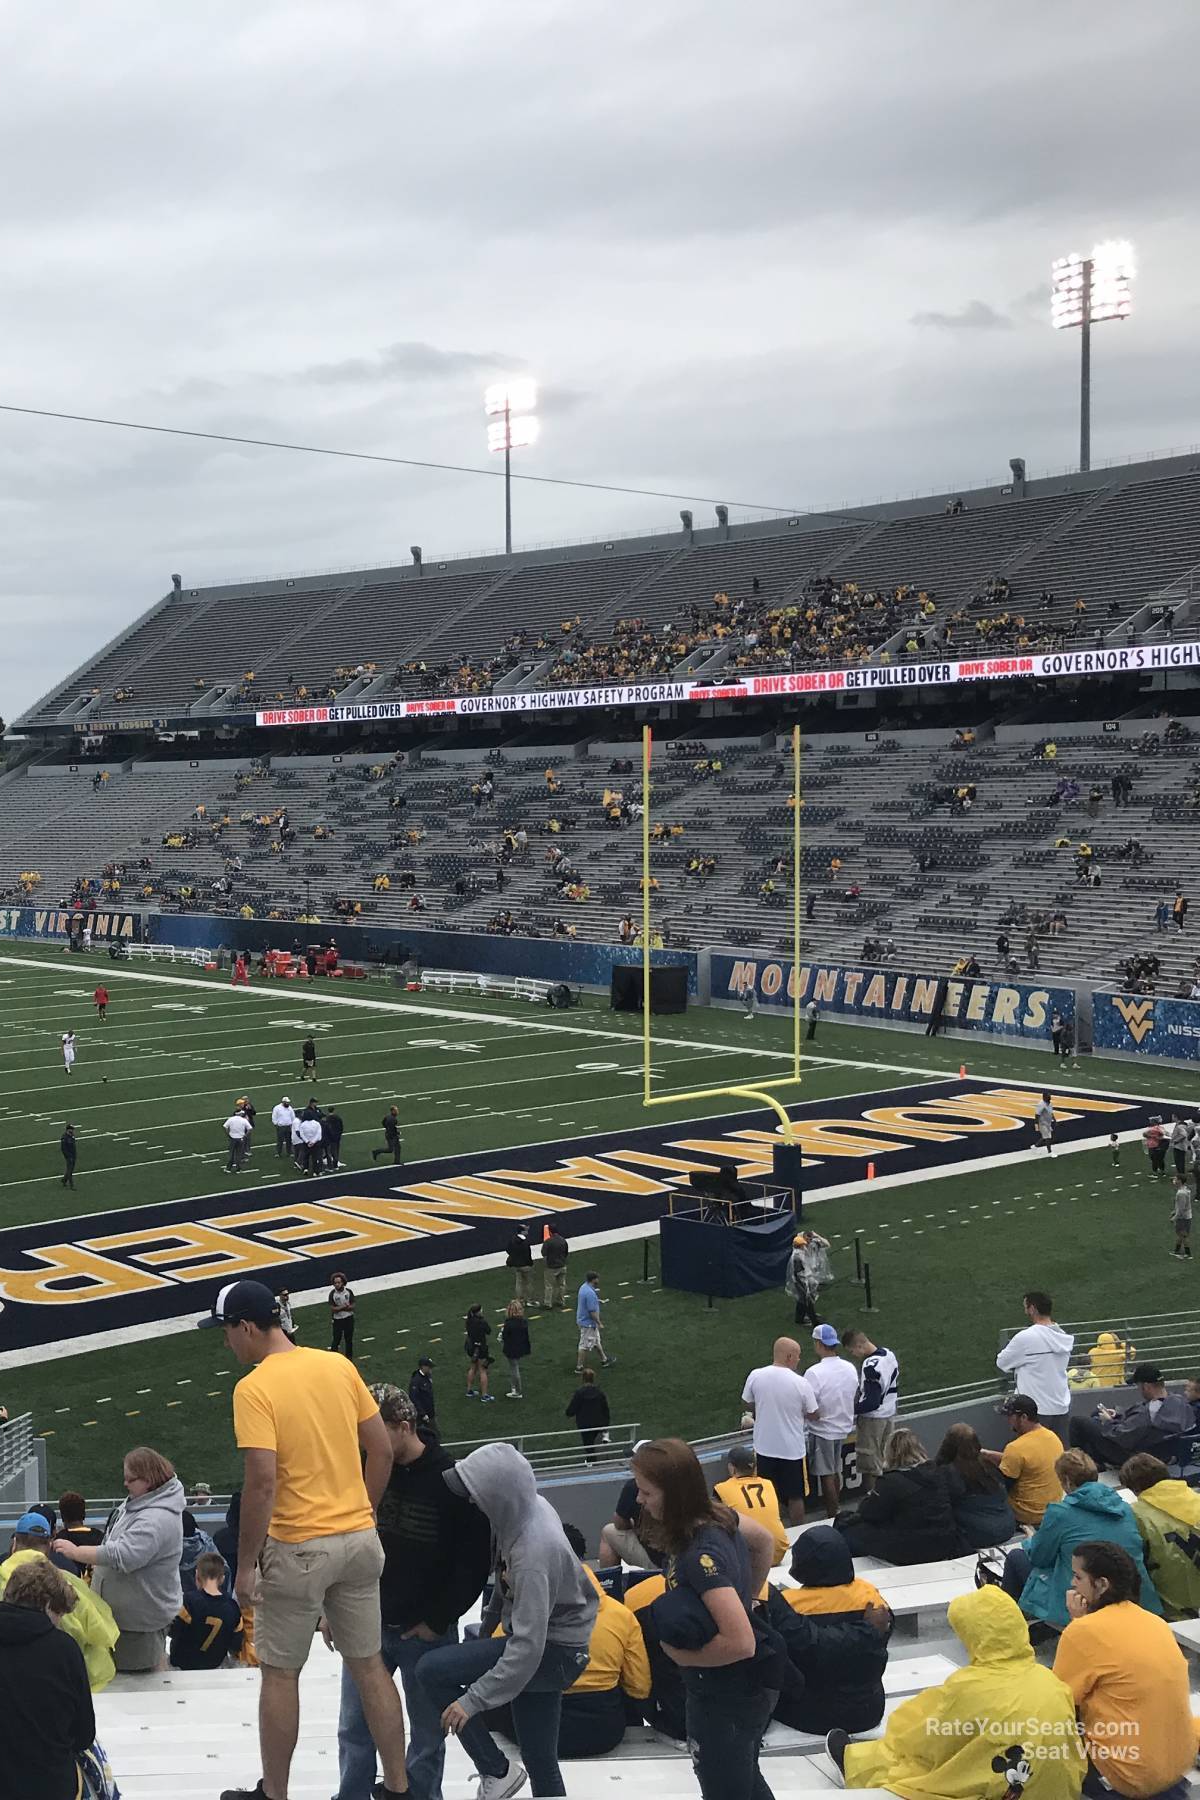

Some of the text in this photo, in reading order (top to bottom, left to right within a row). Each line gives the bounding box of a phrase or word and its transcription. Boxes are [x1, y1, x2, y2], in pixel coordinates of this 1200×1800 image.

[959, 659, 1033, 676] DRIVE SOBER OR
[1042, 649, 1145, 674] GOVERNOR'S
[754, 676, 787, 694] DRIVE
[789, 674, 826, 692] SOBER
[828, 672, 844, 688] OR
[846, 670, 868, 688] GET
[870, 668, 916, 685] PULLED
[918, 665, 951, 683] OVER
[406, 700, 455, 713] DRIVE SOBER OR
[460, 684, 684, 713] GOVERNOR'S HIGHWAY SAFETY PROGRAM
[263, 711, 287, 725] DRIVE
[288, 709, 315, 723] SOBER
[316, 708, 328, 721] OR
[329, 706, 345, 720] GET
[346, 704, 378, 719] PULLED
[379, 703, 401, 718] OVER
[727, 960, 1050, 1029] MOUNTAINEERS
[741, 1484, 766, 1508] 17
[200, 1615, 223, 1652] 7
